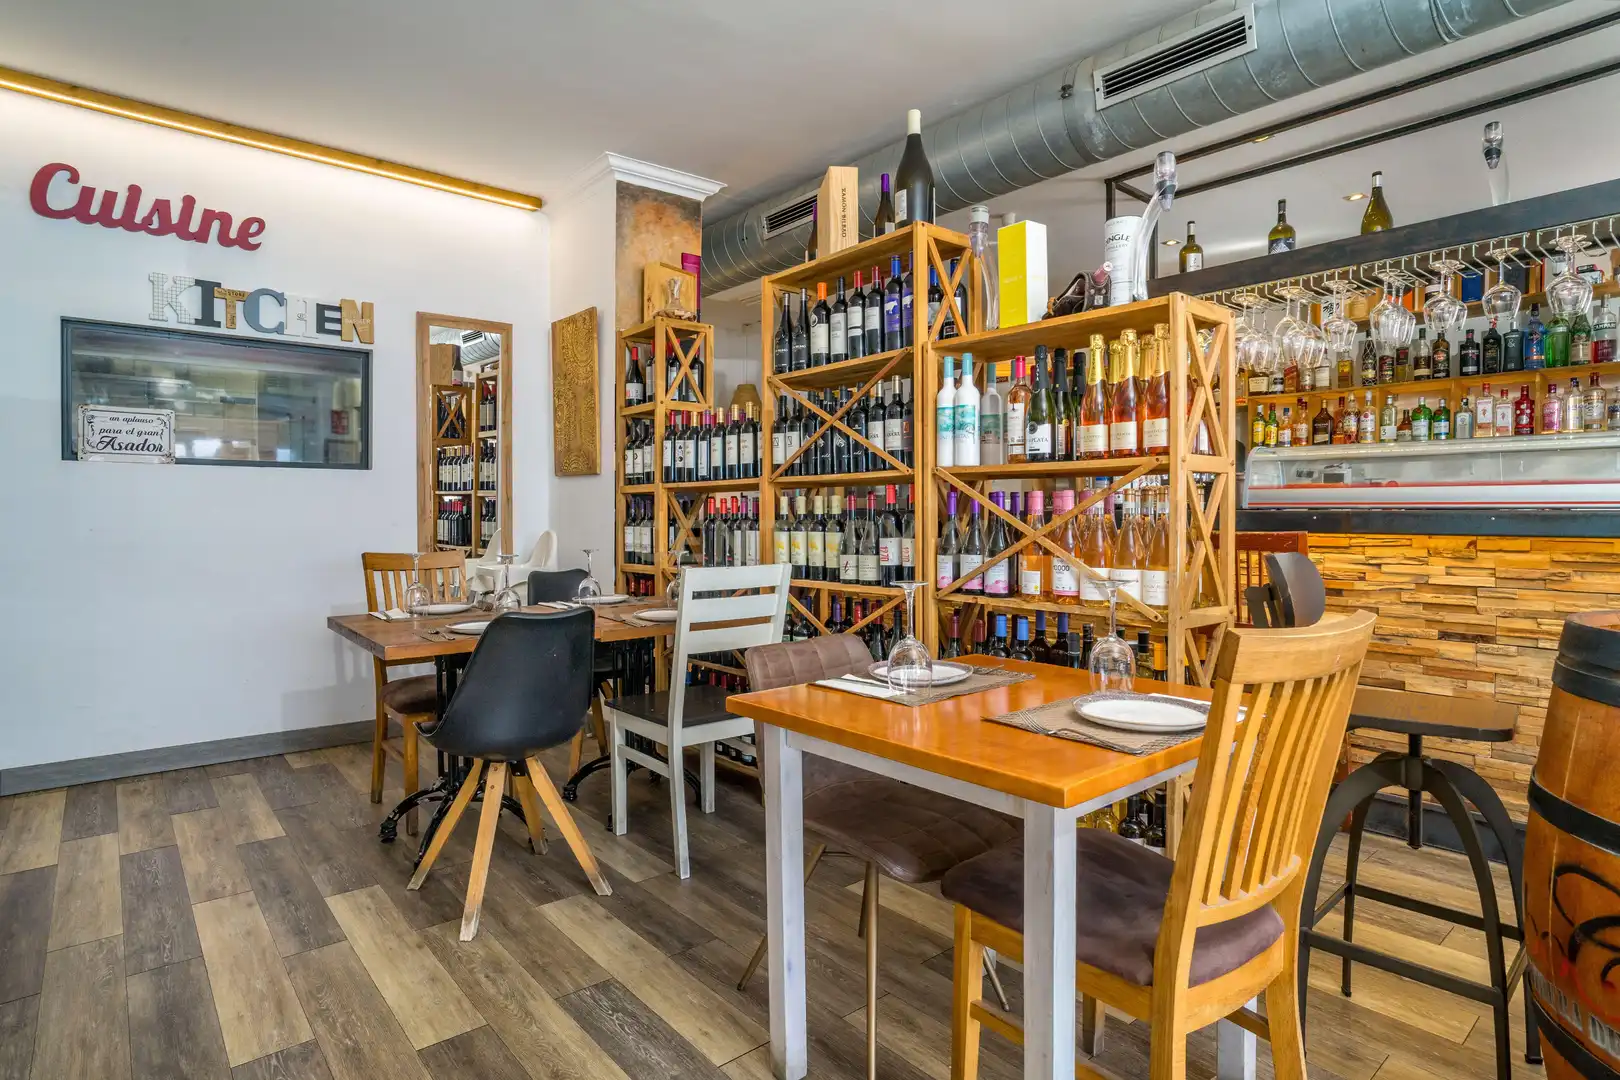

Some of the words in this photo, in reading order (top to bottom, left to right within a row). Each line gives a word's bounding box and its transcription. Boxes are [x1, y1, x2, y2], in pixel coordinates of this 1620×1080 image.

[29, 162, 266, 251] Cuisine
[148, 271, 375, 344] KITCHEN
[122, 415, 154, 424] aplauso
[98, 427, 122, 435] para
[125, 427, 135, 435] el
[136, 430, 159, 438] gran
[1382, 428, 1387, 436] 3
[95, 435, 164, 453] Asador
